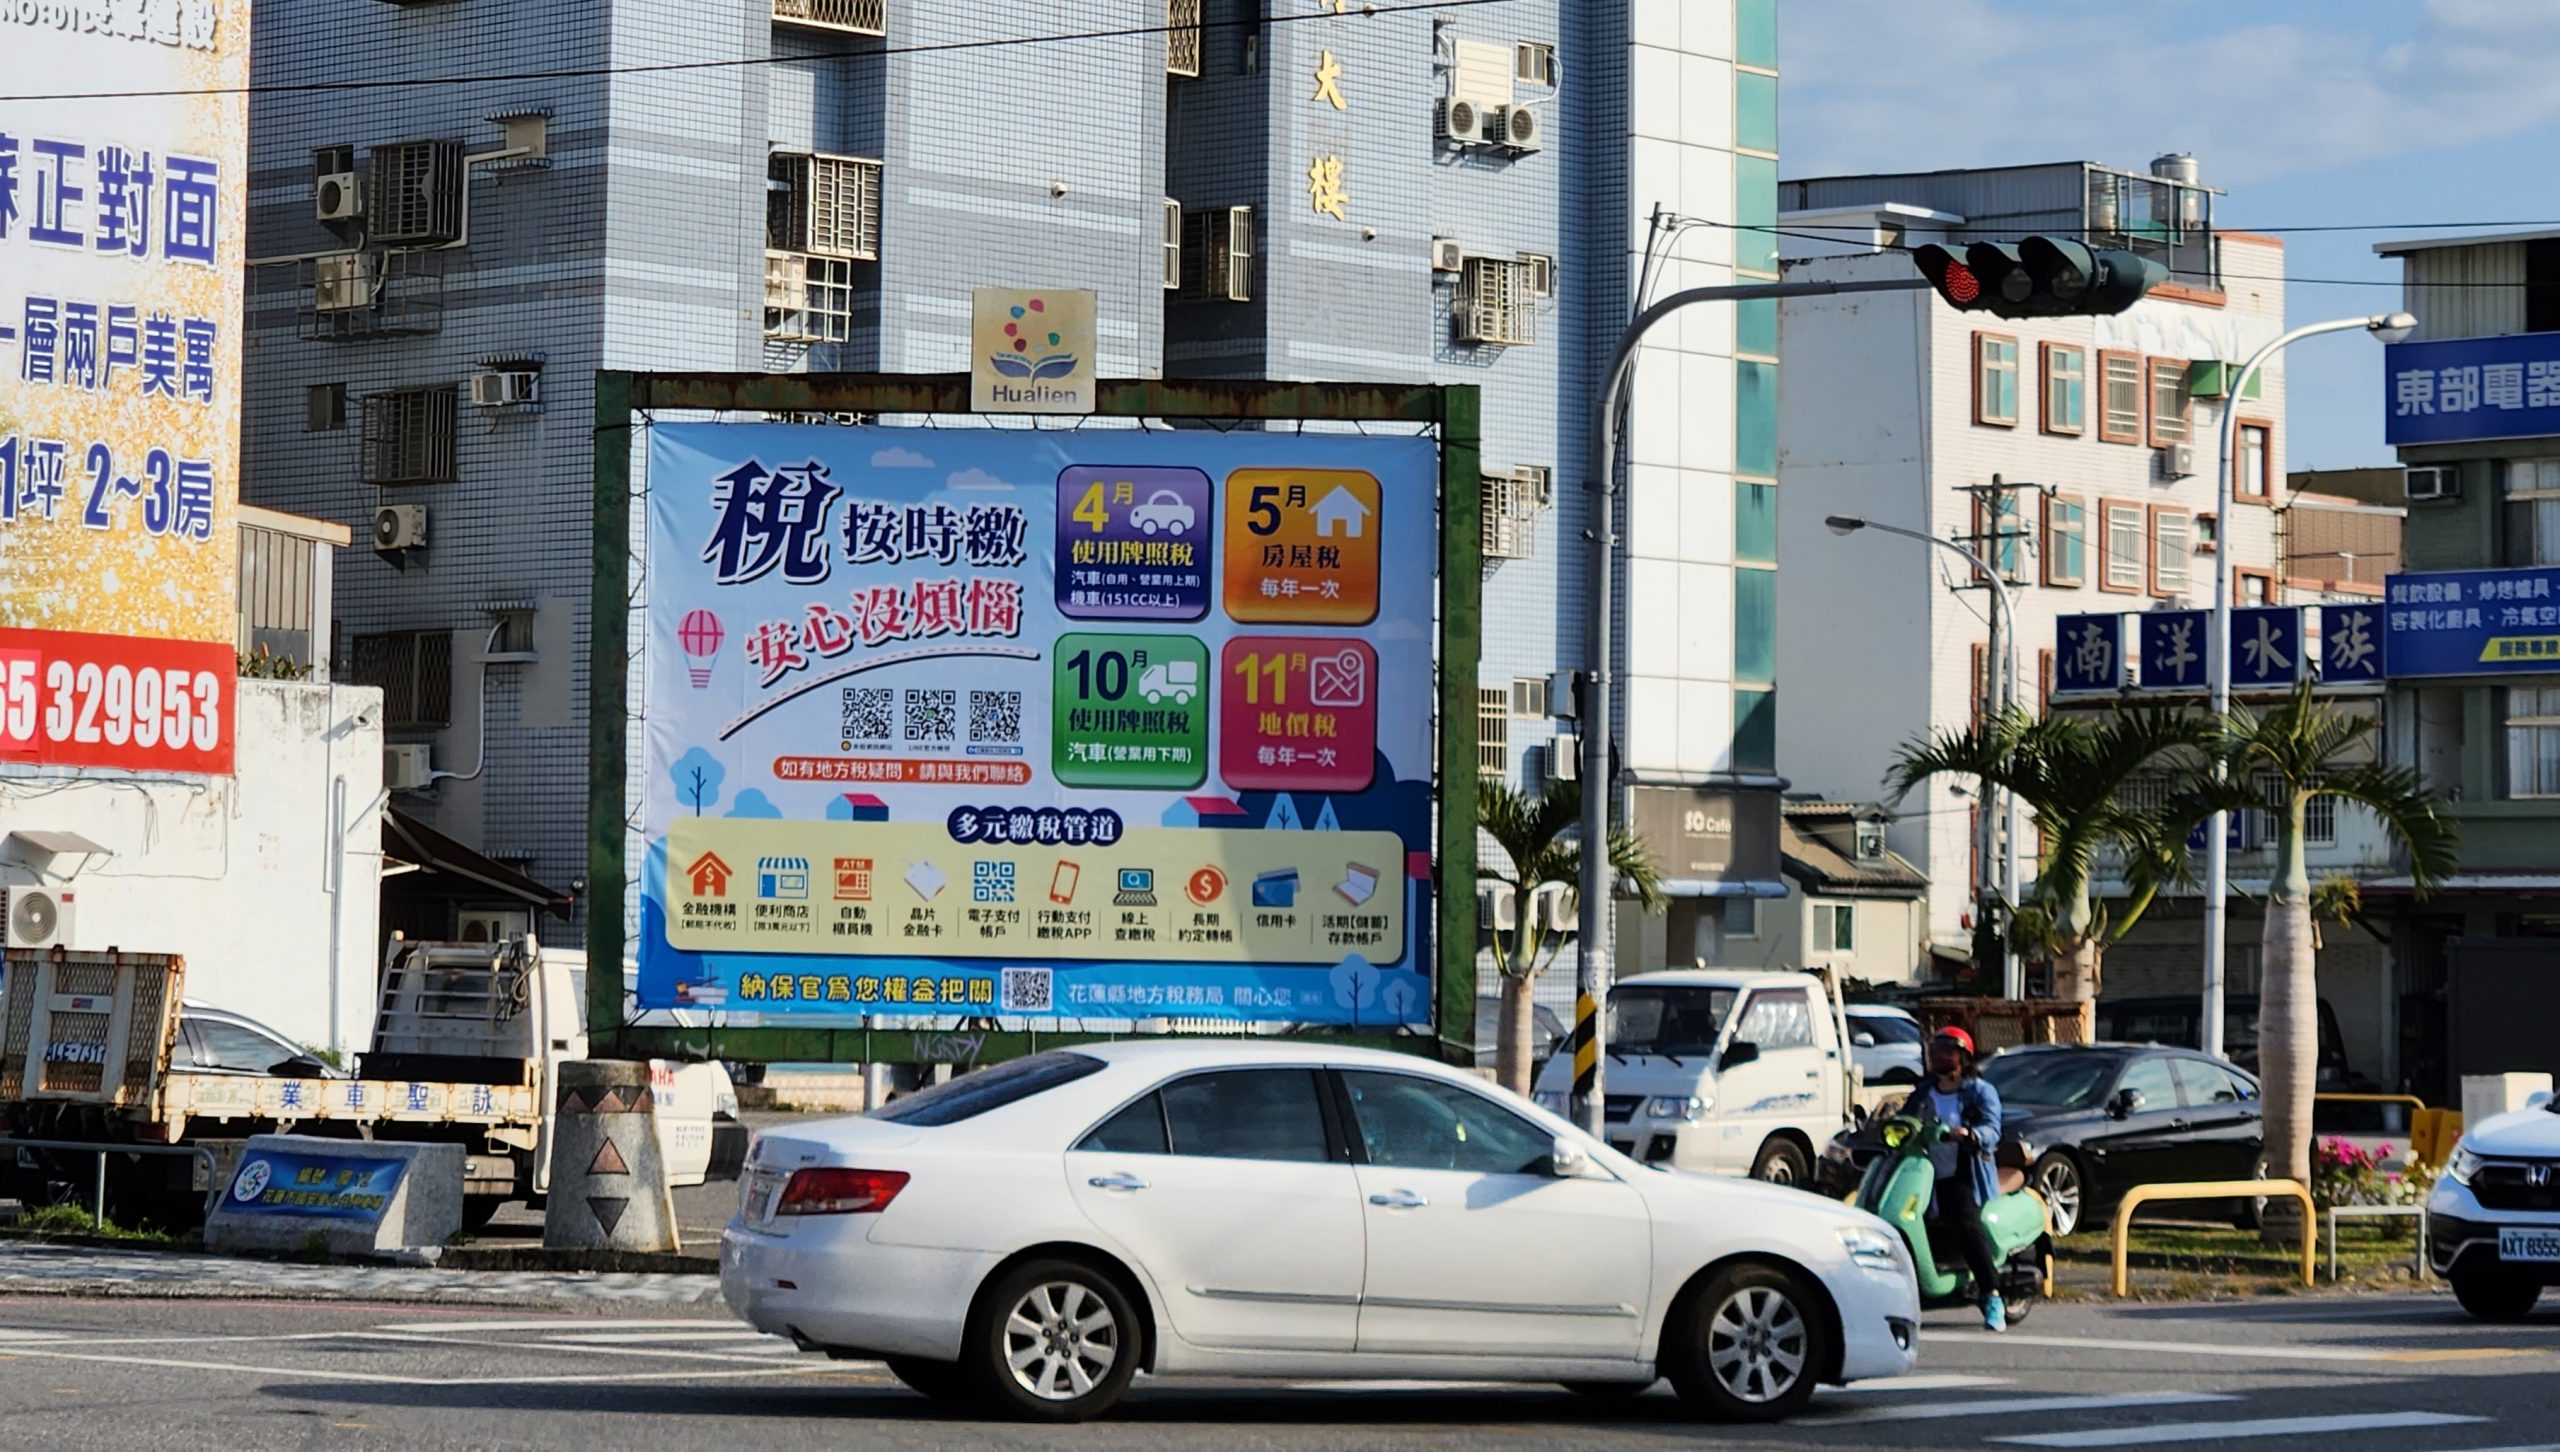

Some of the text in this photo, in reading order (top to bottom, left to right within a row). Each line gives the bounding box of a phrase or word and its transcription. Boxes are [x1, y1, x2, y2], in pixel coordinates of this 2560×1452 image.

[992, 385, 1077, 404] Hualien
[2396, 361, 2560, 416] 東部電器
[1072, 481, 1134, 532] 4月
[1247, 485, 1306, 536] 5月
[703, 459, 1024, 580] 稅 按時繳
[1071, 539, 1194, 566] 使用牌照稅
[1262, 544, 1340, 569] 房屋稅
[1260, 578, 1340, 599] 每年一次
[1071, 590, 1180, 608] 機車(151CC以上)
[745, 580, 1021, 686] 安心沒煩惱
[1066, 650, 1147, 700] 10月
[1235, 653, 1307, 704] 11月
[46, 660, 220, 751] 329953
[1069, 708, 1190, 733] 使用牌照稅
[1258, 712, 1337, 738] 地價稅
[1068, 742, 1192, 763] 汽車(營業用下期)
[1257, 746, 1336, 767] 每年一次
[956, 813, 1115, 841] 多元繳稅管道
[841, 860, 866, 869] ATM
[682, 902, 736, 917] 金融機構
[755, 904, 809, 918] 便利商店
[840, 906, 867, 920] 自動
[910, 908, 936, 921] 晶片
[968, 909, 1020, 923] 電子支付
[1037, 910, 1091, 925] 行動支付
[1121, 912, 1148, 925] 線上
[1192, 913, 1219, 926] 長期
[1256, 914, 1297, 928] 信用卡
[833, 922, 873, 937] 櫃員機
[903, 923, 943, 937] 金融卡
[979, 925, 1007, 938] 帳戶
[1036, 926, 1092, 940] 繳稅APP
[1114, 928, 1156, 943] 查繳稅
[1178, 929, 1233, 943] 約定轉帳
[1328, 931, 1382, 946] 存款帳戶
[1069, 984, 1224, 1005] 花蓮縣地方稅務局
[1234, 986, 1292, 1006] 關心您
